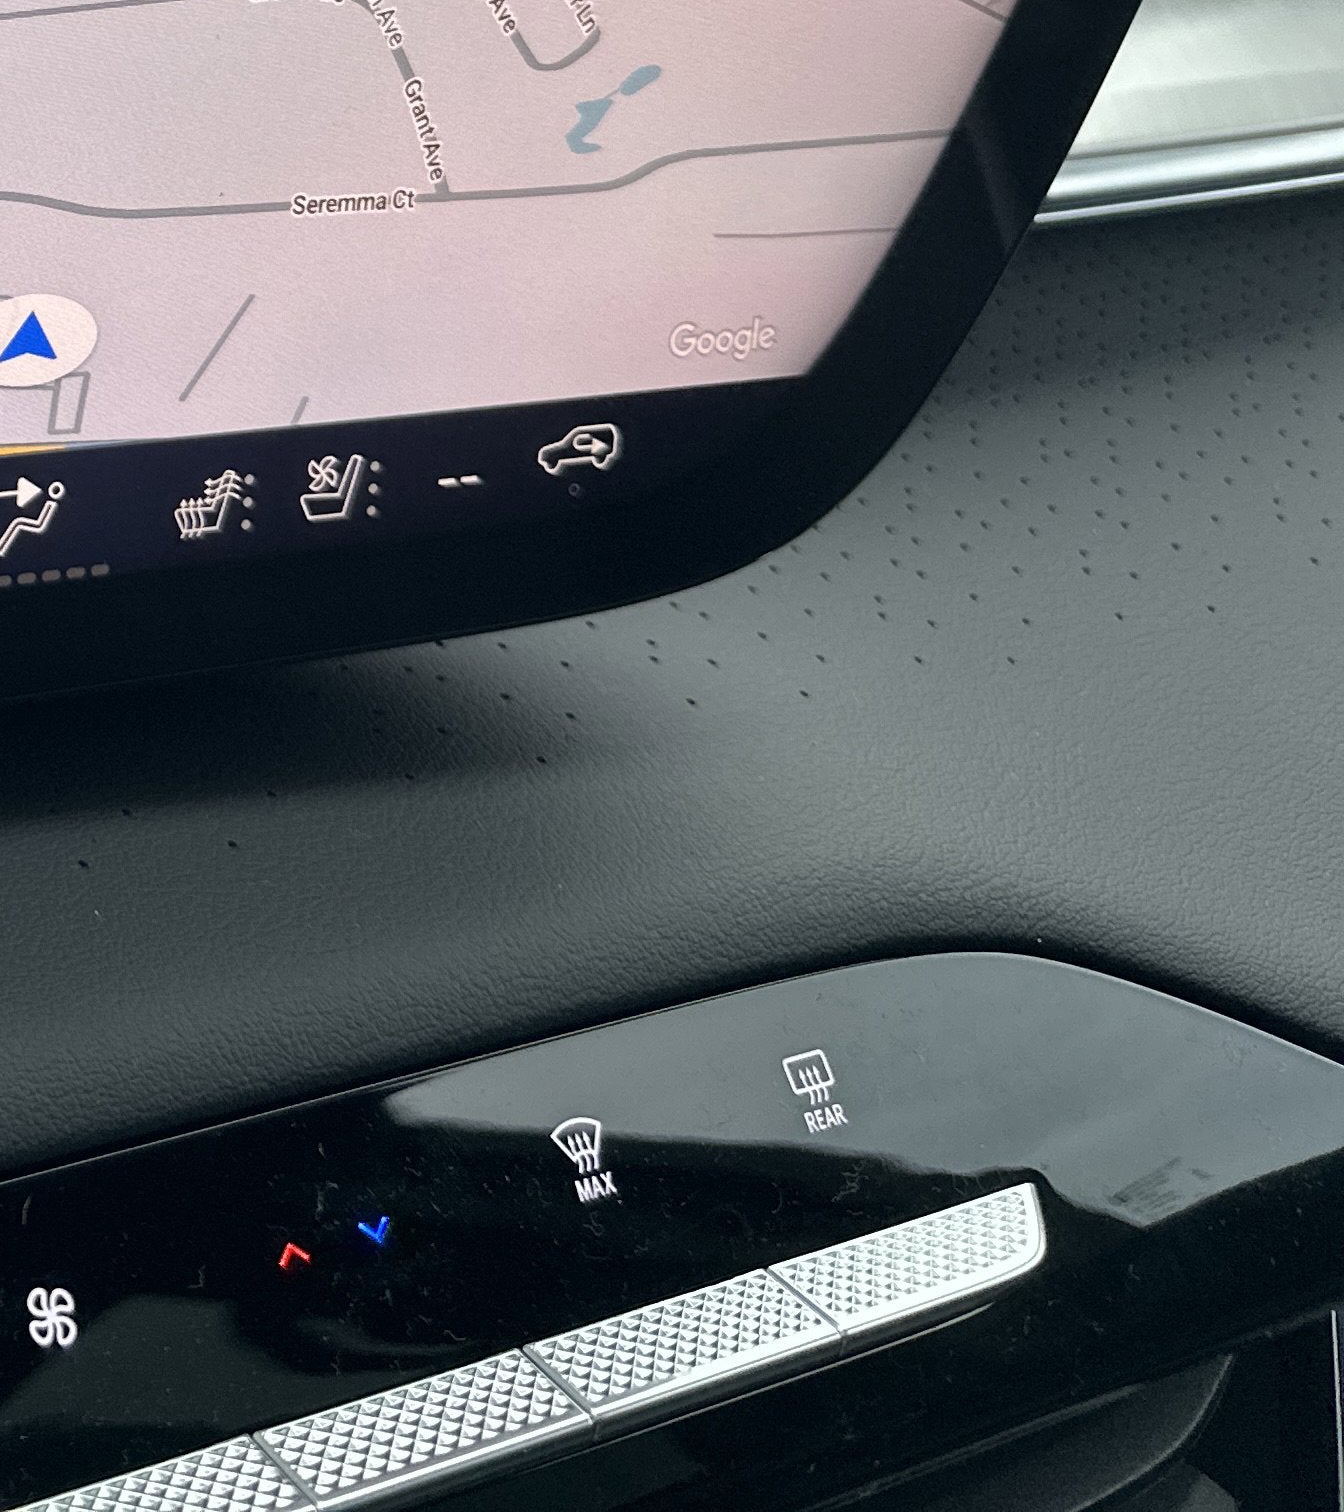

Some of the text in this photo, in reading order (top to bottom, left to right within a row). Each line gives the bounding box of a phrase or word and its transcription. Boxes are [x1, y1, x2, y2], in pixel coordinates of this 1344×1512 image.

[376, 7, 404, 48] Ave
[575, 5, 598, 34] Ln
[404, 78, 444, 181] Grant Ave
[291, 189, 415, 215] Seremma Ct
[669, 316, 778, 361] Google
[803, 1102, 849, 1134] REAR
[573, 1170, 618, 1204] MAX
